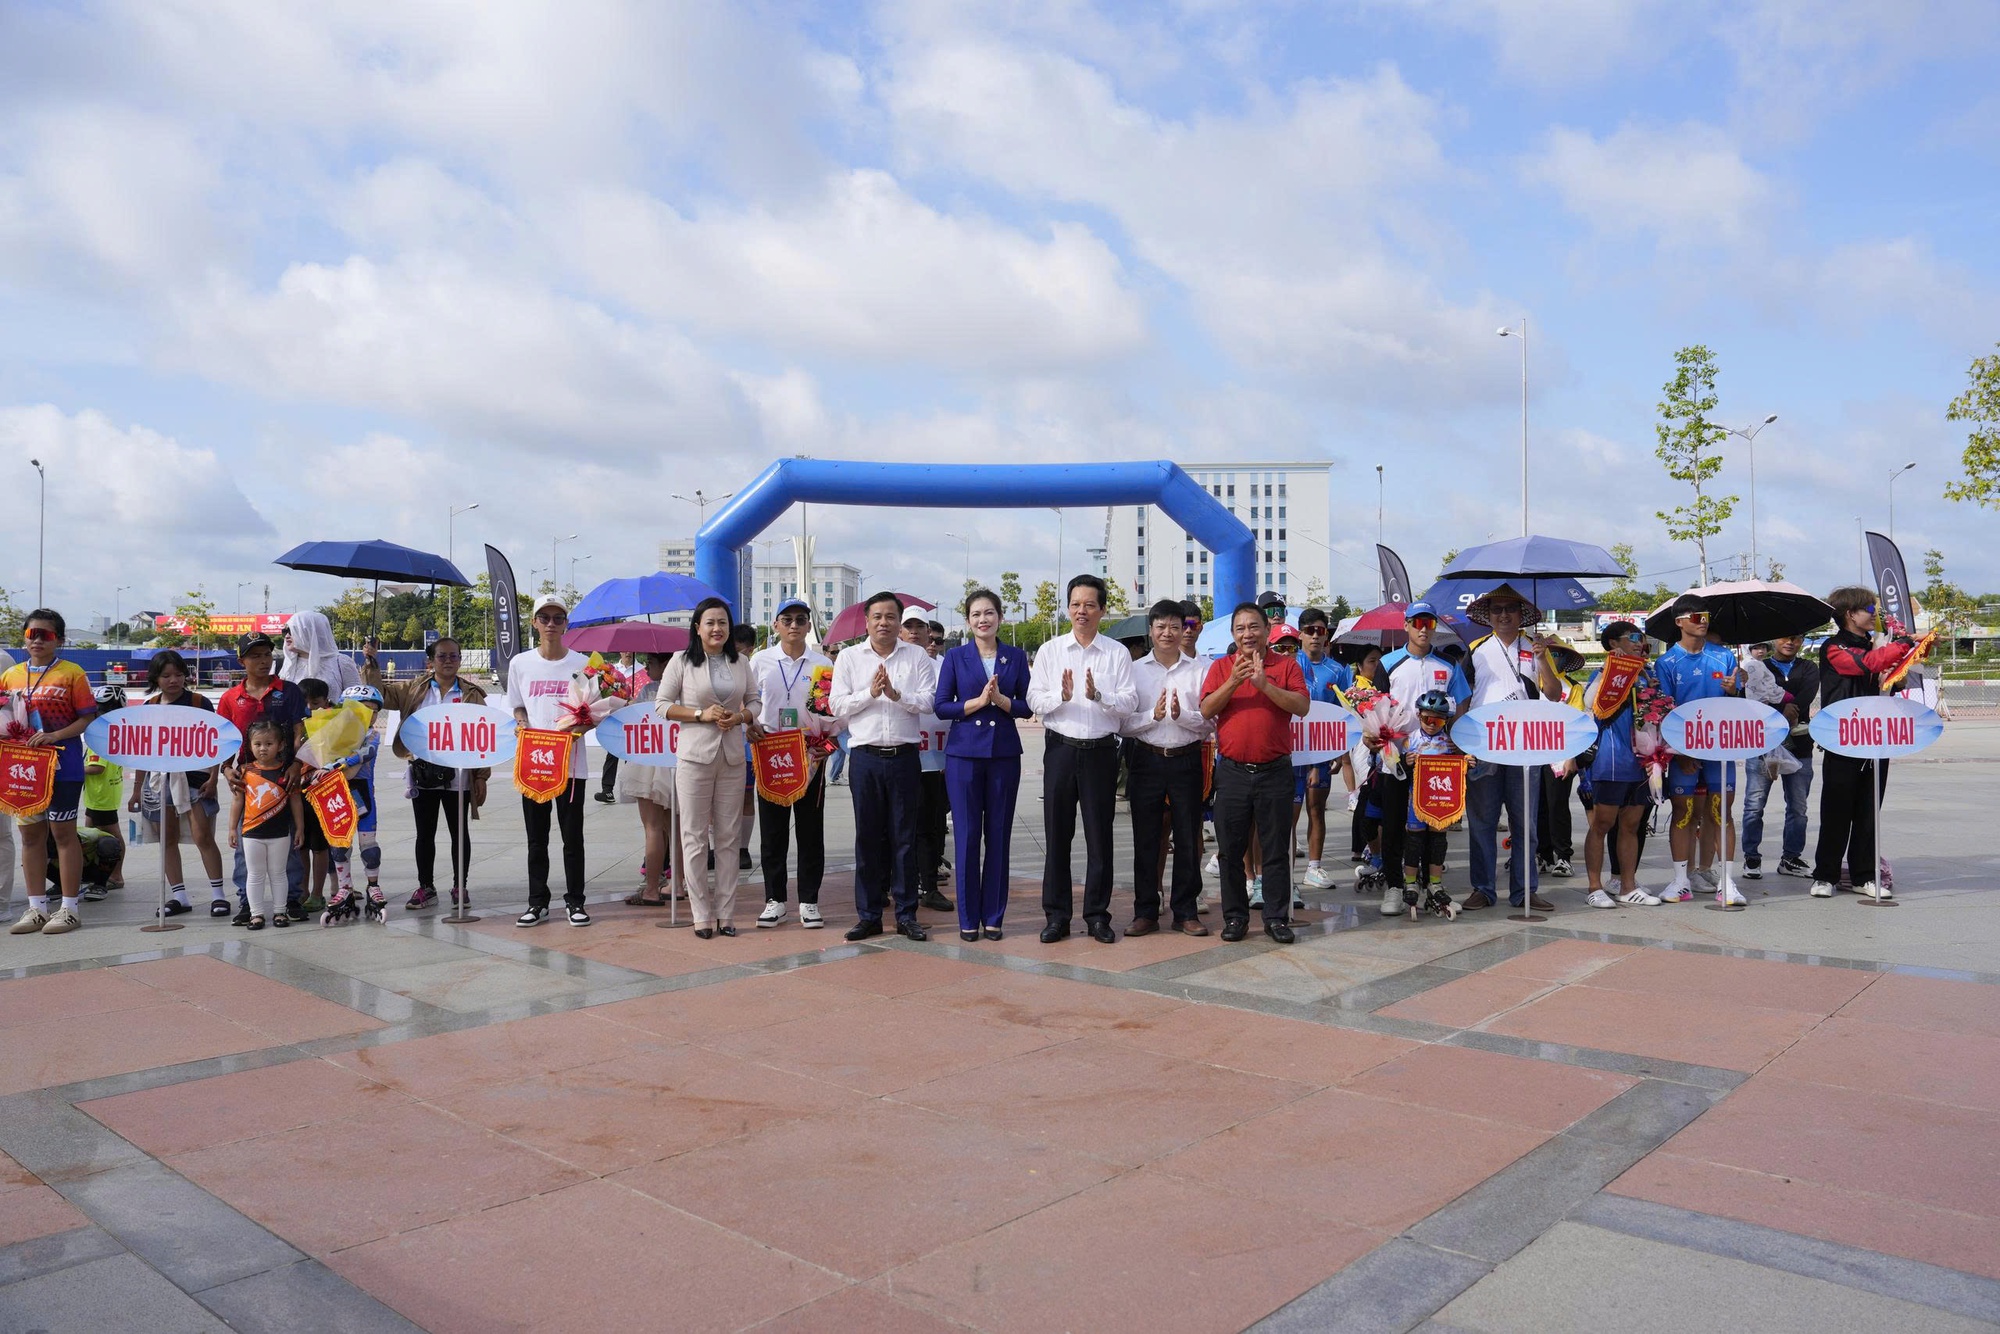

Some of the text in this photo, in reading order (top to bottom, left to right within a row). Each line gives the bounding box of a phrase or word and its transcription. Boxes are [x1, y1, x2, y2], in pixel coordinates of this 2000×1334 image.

[529, 680, 570, 696] IRSC
[108, 718, 218, 758] BÌNH PHƯỚC
[428, 716, 496, 758] HÀ NỘI
[624, 714, 680, 754] TIỀN G
[1290, 716, 1346, 752] HÍ MINH
[1486, 714, 1564, 750] TÂY NINH
[1685, 709, 1764, 750] BẮC GIANG
[1839, 708, 1914, 746] ĐỒNG NAI
[49, 809, 78, 821] SUG
